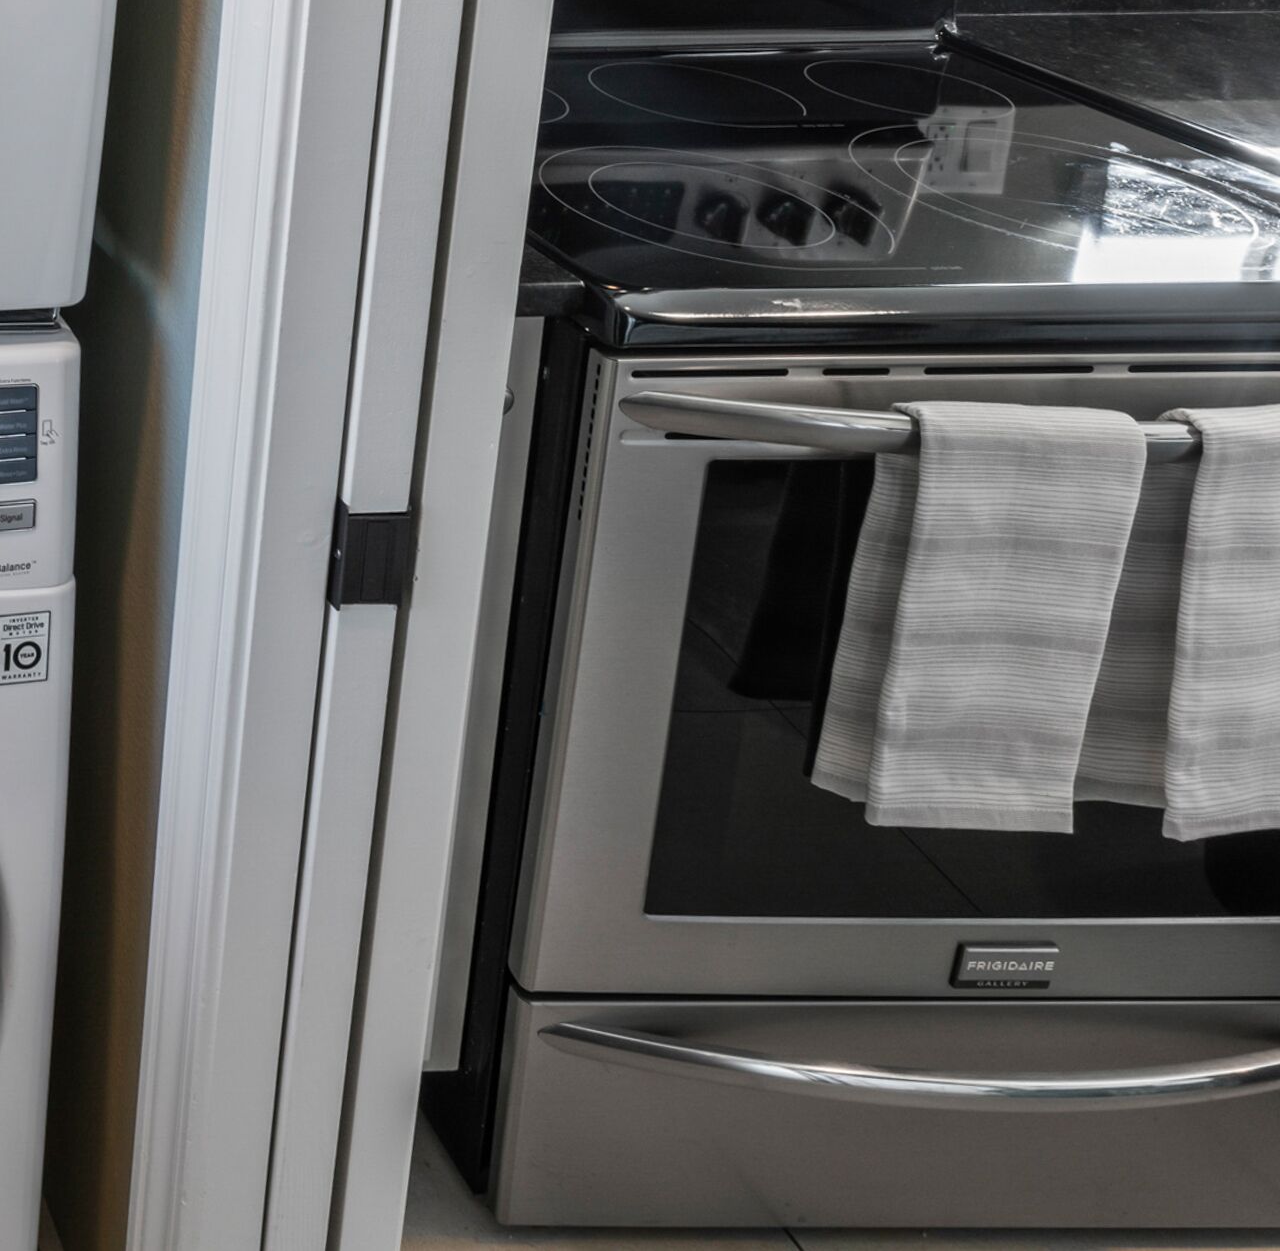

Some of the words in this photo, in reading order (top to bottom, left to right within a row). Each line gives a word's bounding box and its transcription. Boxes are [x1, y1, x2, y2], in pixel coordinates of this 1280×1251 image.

[0, 513, 23, 523] Signal
[3, 641, 42, 671] 10
[1, 672, 42, 681] WARRANTY
[967, 961, 1056, 971] FRIGIDAIRE
